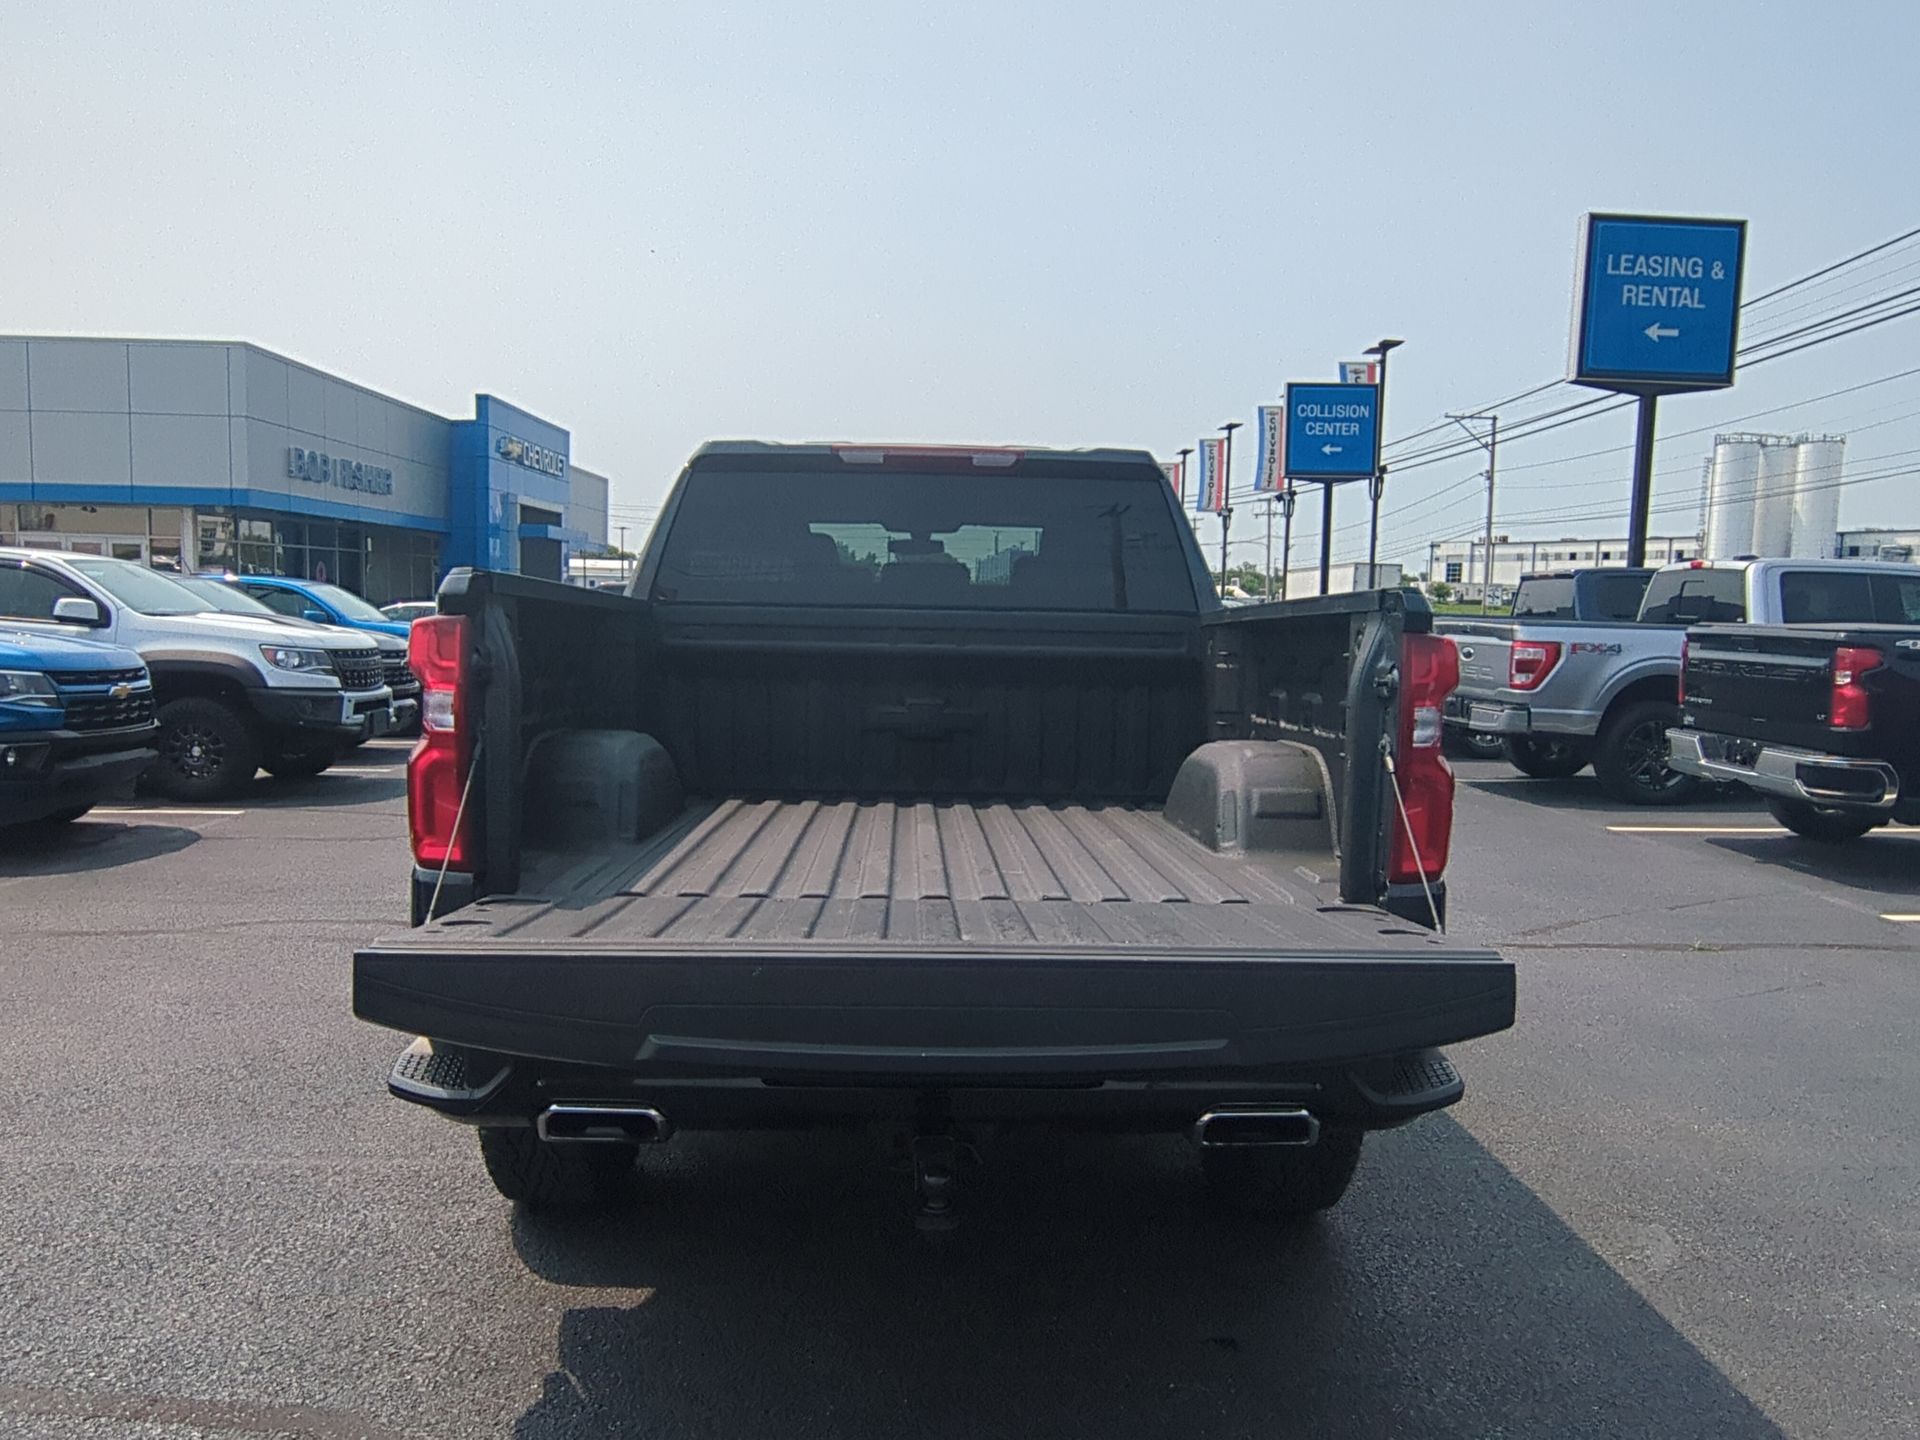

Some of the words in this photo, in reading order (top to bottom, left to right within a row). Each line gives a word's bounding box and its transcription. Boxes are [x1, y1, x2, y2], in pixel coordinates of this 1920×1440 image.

[1607, 254, 1704, 279] LEASING
[1711, 260, 1725, 280] &
[1622, 284, 1706, 309] RENTAL
[1297, 404, 1370, 418] COLLISION
[1305, 421, 1360, 437] CENTER
[287, 446, 331, 484] BOB
[524, 441, 568, 478] CHEVROLET
[1266, 417, 1276, 488] CHEVROLET
[1571, 642, 1622, 656] FX4
